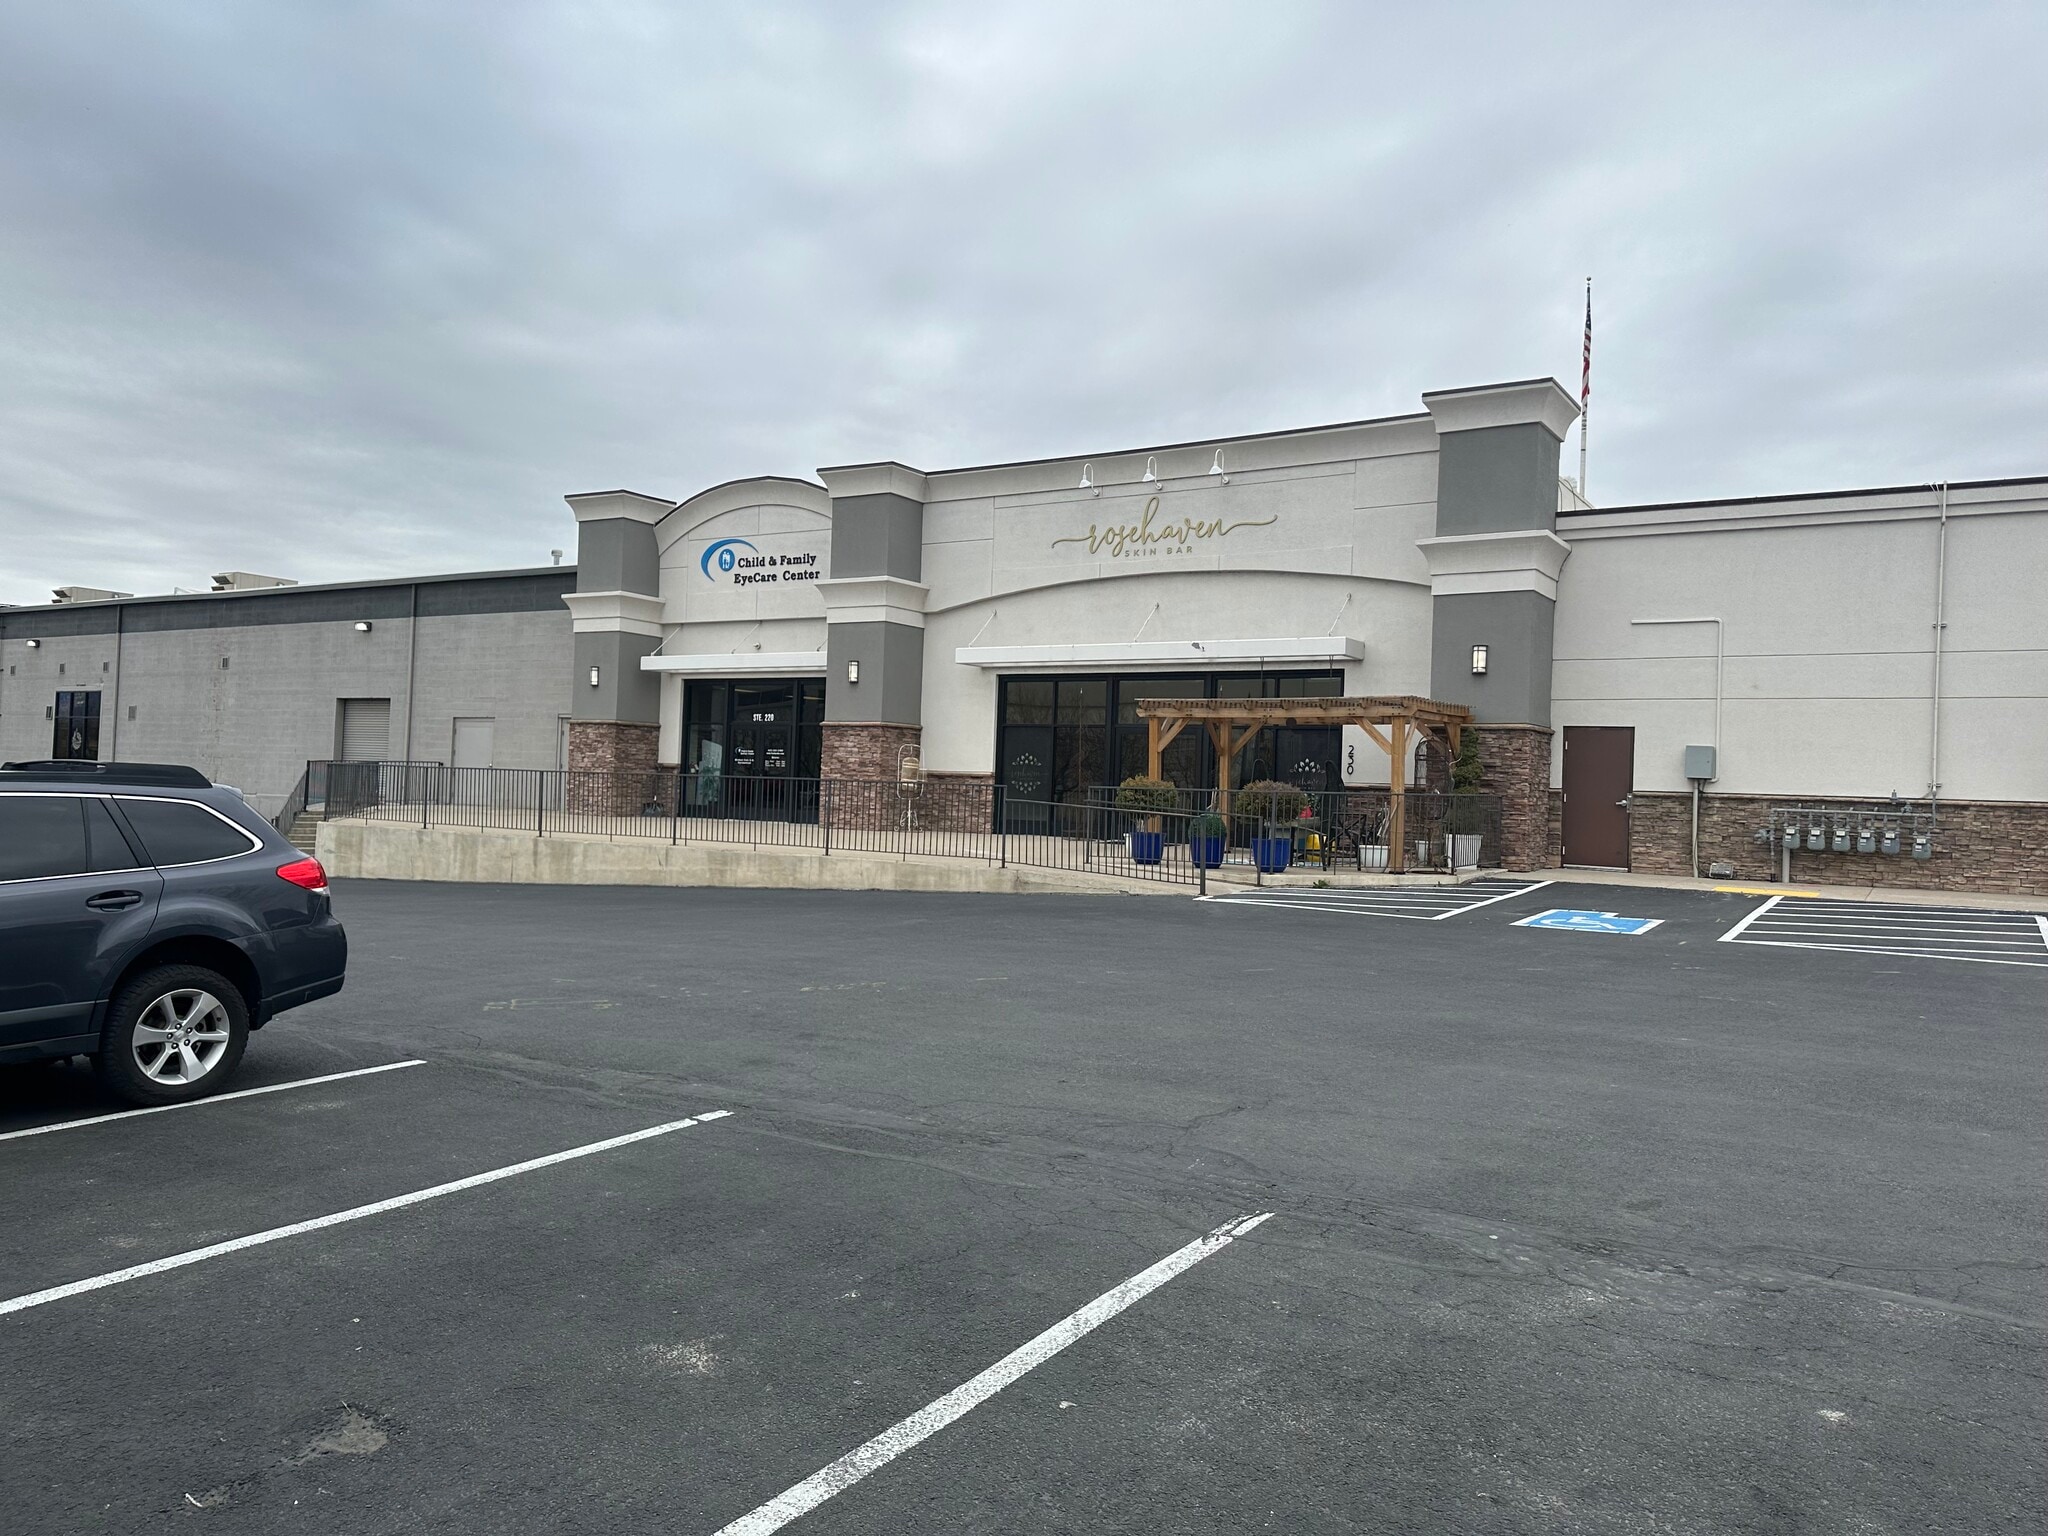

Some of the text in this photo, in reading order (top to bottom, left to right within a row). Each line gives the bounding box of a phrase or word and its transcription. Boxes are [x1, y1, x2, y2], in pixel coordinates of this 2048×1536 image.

[1051, 496, 1278, 557] rosehaven
[1124, 545, 1193, 557] SKIN BAR
[738, 553, 816, 568] Child & Family
[734, 570, 820, 585] EyeCare Center
